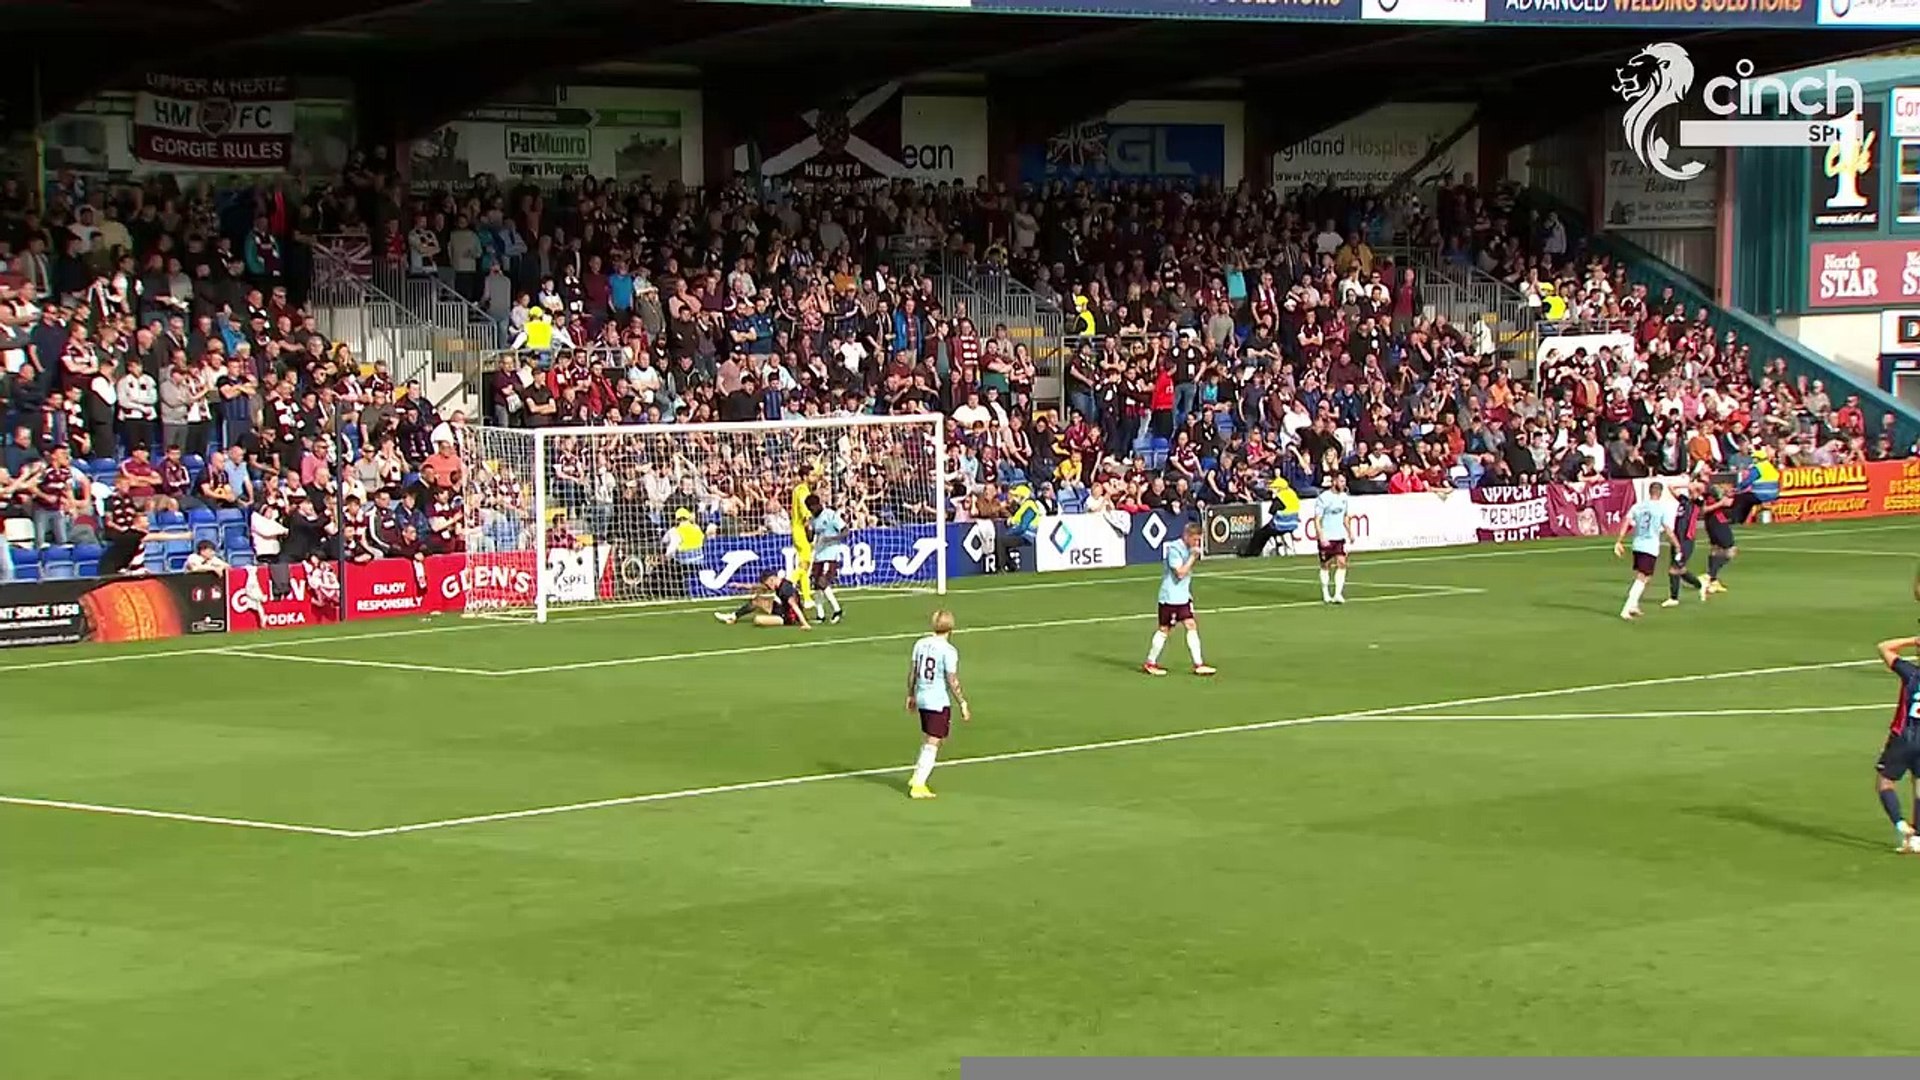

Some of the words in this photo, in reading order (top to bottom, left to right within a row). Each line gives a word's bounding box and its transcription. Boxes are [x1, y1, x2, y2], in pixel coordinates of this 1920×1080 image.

[155, 100, 191, 127] HM
[240, 105, 271, 128] FC
[151, 136, 217, 159] GORGIE
[222, 141, 284, 160] RULES
[902, 144, 953, 169] ean
[1824, 251, 1861, 270] North
[1820, 267, 1879, 299] STAR
[1783, 465, 1867, 487] DINGWALL
[1483, 485, 1532, 502] UPPER
[1070, 548, 1102, 566] RSE
[374, 582, 406, 595] ENJOY
[441, 565, 531, 599] GLEN'S
[0, 607, 14, 620] NT
[16, 605, 50, 620] SINCE
[52, 603, 79, 618] 1958
[357, 597, 423, 611] RESPONSIBLY
[264, 612, 305, 626] ODKA
[918, 654, 936, 681] 18
